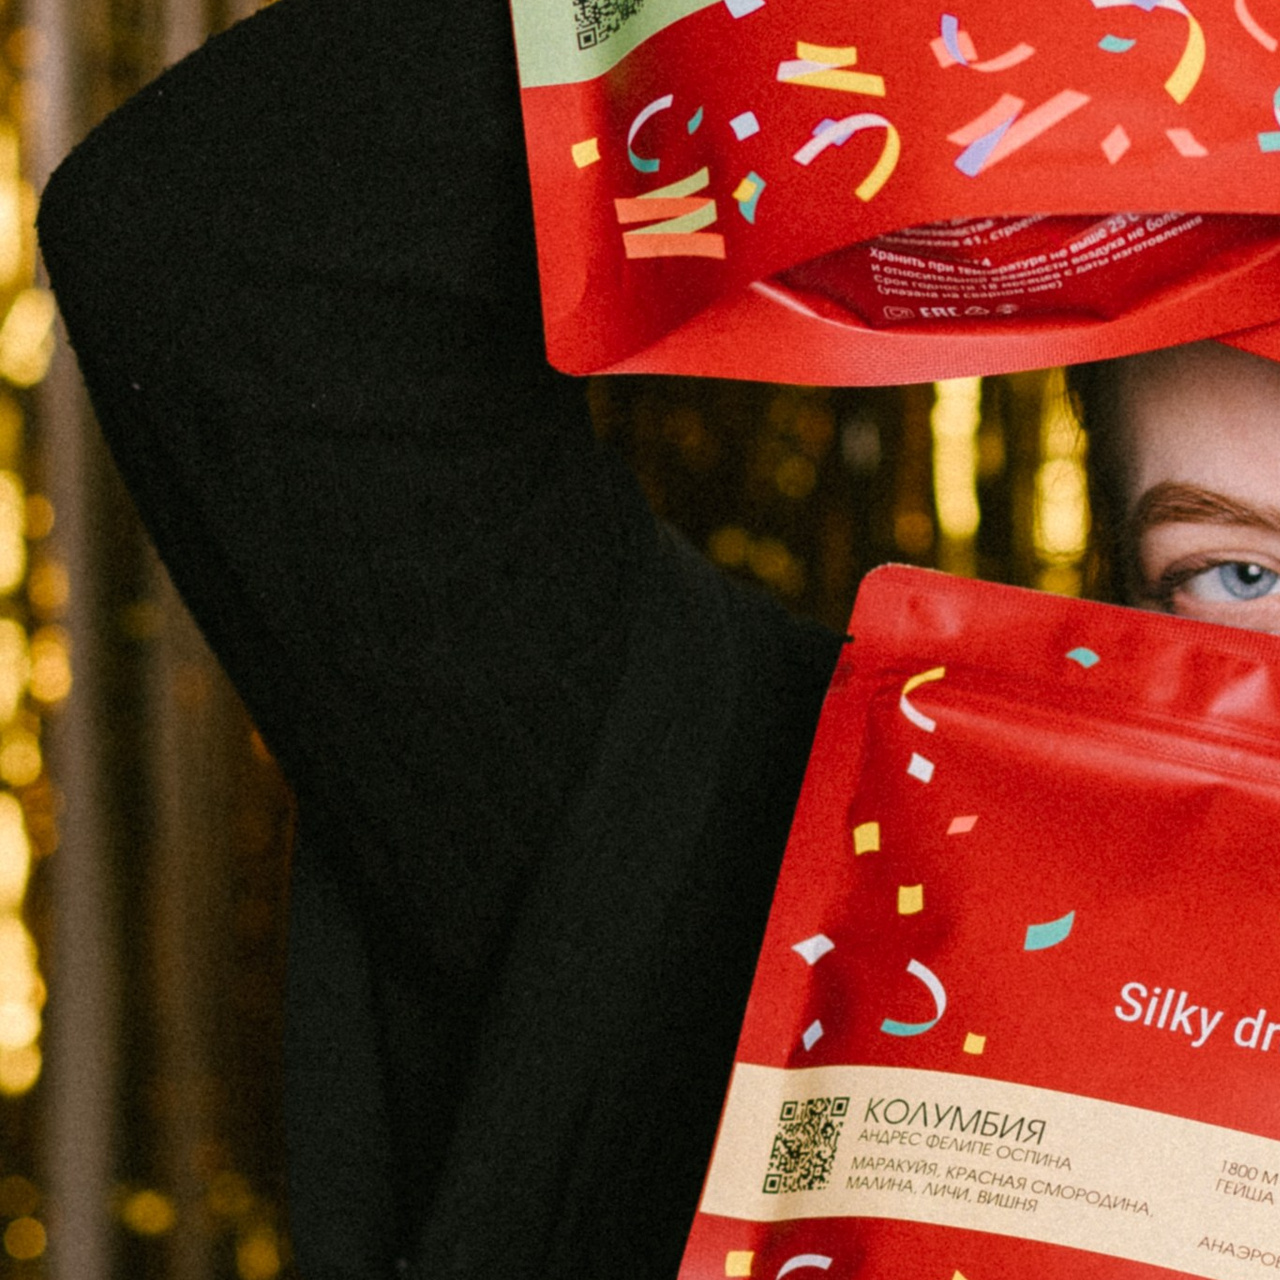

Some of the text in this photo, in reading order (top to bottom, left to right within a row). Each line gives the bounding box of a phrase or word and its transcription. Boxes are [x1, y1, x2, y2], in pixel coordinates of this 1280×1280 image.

[869, 247, 926, 269] Хранить
[928, 260, 955, 274] при
[1050, 248, 1068, 261] не
[1069, 227, 1108, 254] выше
[1107, 217, 1128, 234] 25
[871, 263, 881, 273] и
[883, 265, 988, 284] относительной
[1070, 236, 1126, 266] воздуха
[1127, 226, 1145, 242] не
[873, 274, 909, 288] Срок
[1076, 257, 1109, 275] даты
[1112, 215, 1203, 262] изготовления
[1115, 982, 1224, 1048] Silky
[864, 1097, 1046, 1145] КОЛУМБИЯ
[858, 1128, 1073, 1171] АНДРЕС ФЕЛИПЕ ОСПИНА
[945, 1165, 1028, 1191] КРАСНАЯ
[1215, 1177, 1275, 1206] ГЕЙША
[1221, 1160, 1279, 1186] 1800 М
[976, 1191, 1038, 1213] ВИШНЯ
